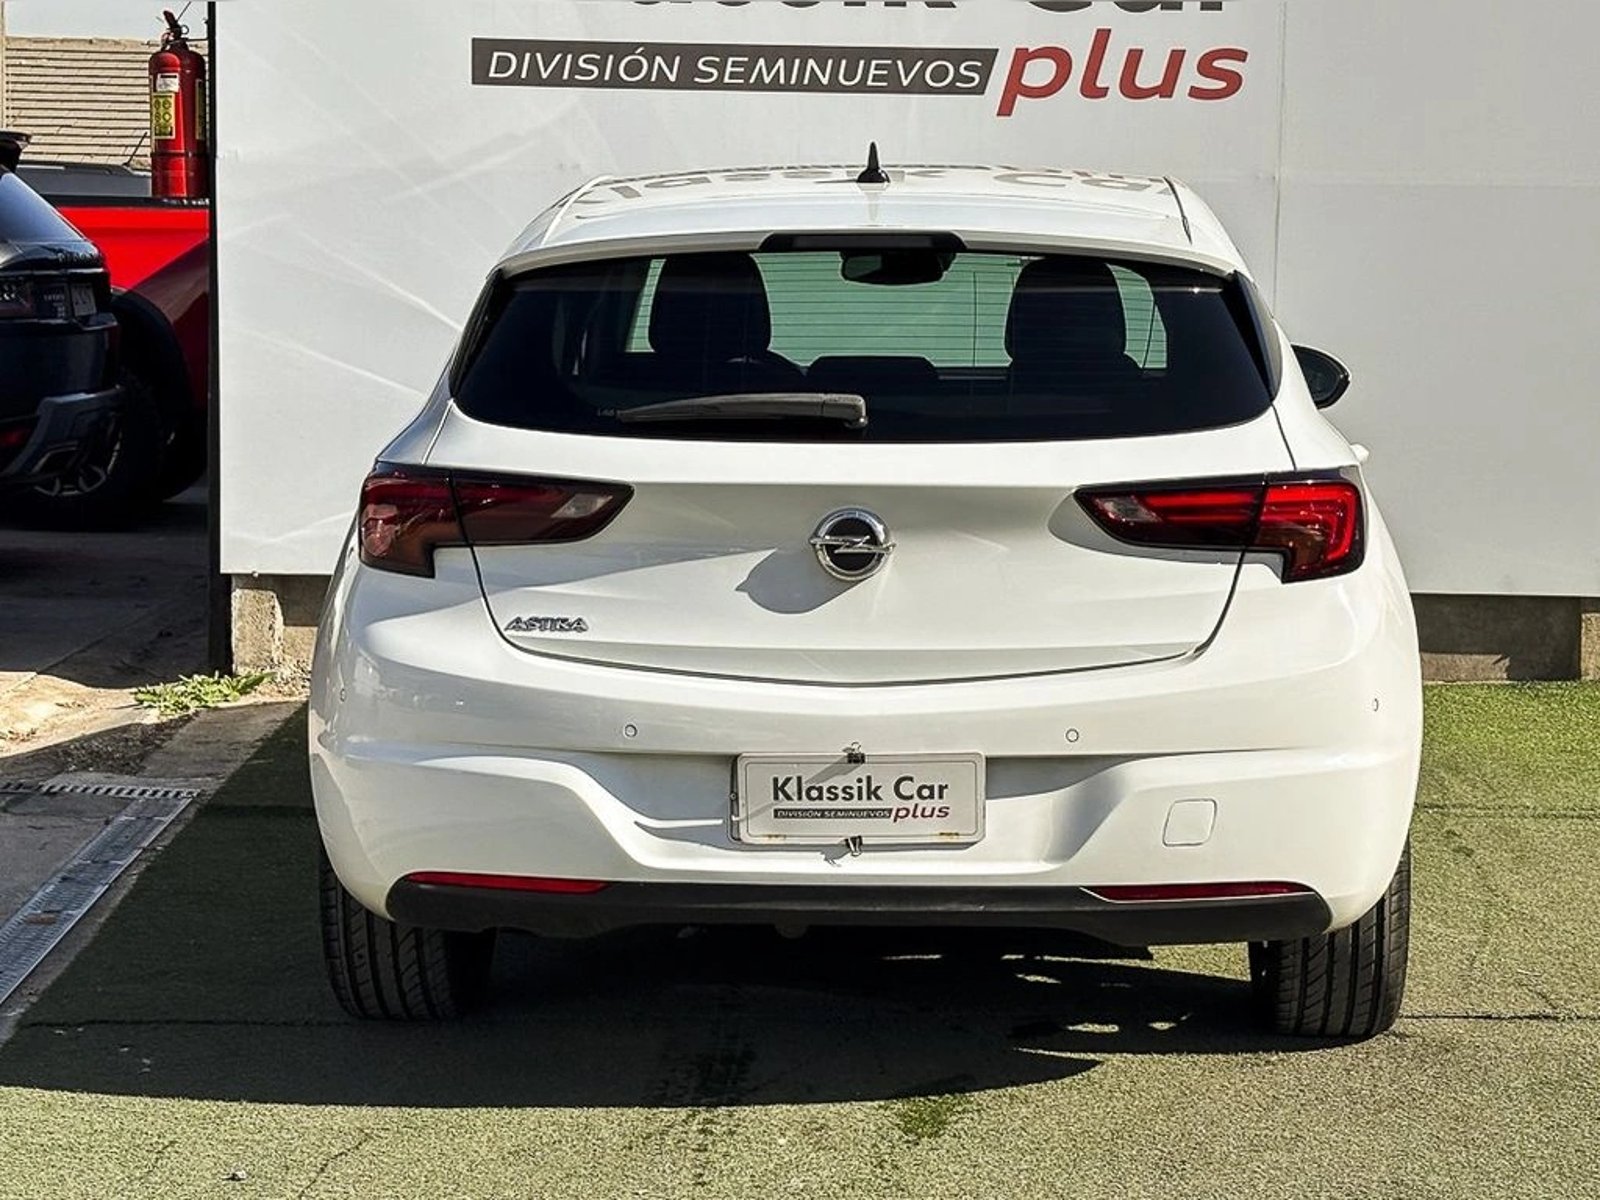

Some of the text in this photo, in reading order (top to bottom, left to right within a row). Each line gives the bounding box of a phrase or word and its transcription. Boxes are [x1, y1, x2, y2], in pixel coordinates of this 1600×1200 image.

[488, 28, 1248, 117] DIVISIÓN SEMINUEVOS plus
[772, 775, 949, 801] Klassik Car
[824, 810, 890, 818] SEMINUEVOS
[892, 803, 951, 823] plus
